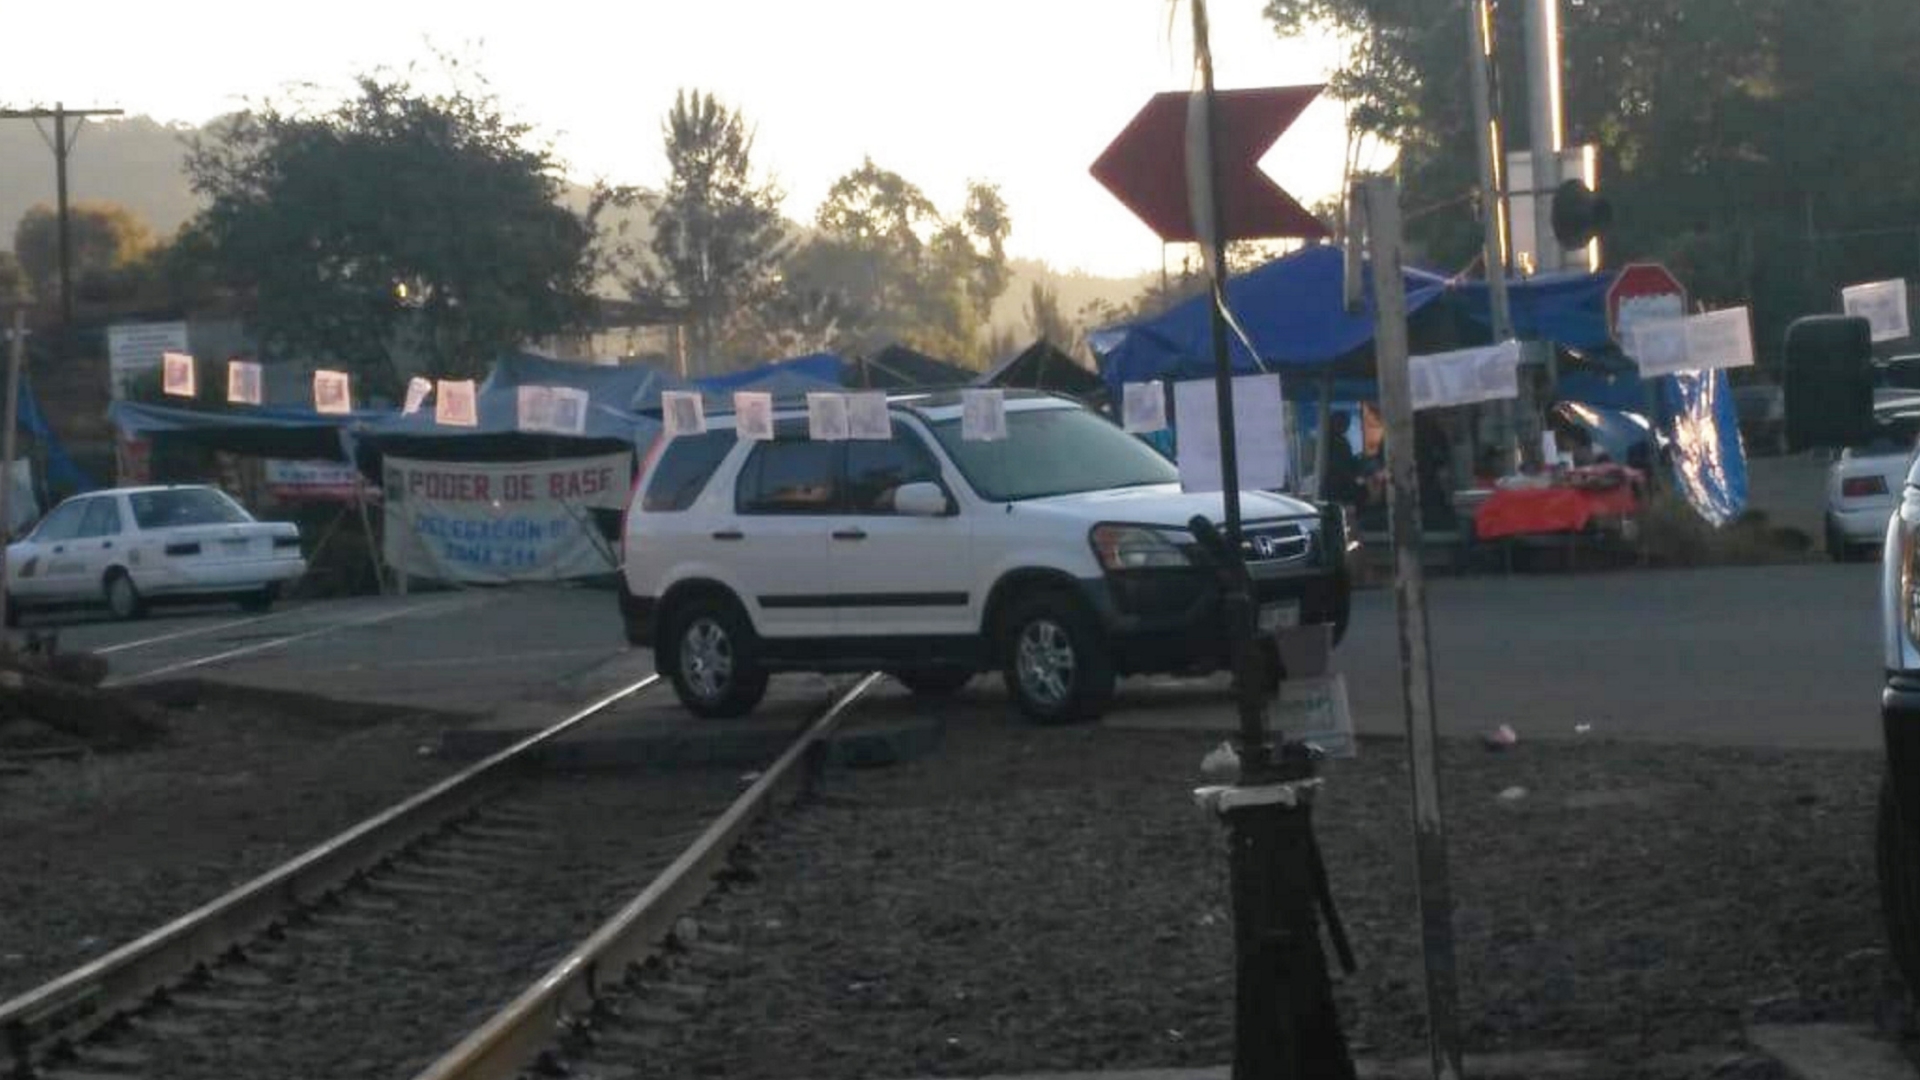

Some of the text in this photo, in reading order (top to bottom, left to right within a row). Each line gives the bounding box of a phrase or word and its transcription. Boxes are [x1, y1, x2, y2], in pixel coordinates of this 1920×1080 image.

[408, 466, 615, 500] PODER DE BASE
